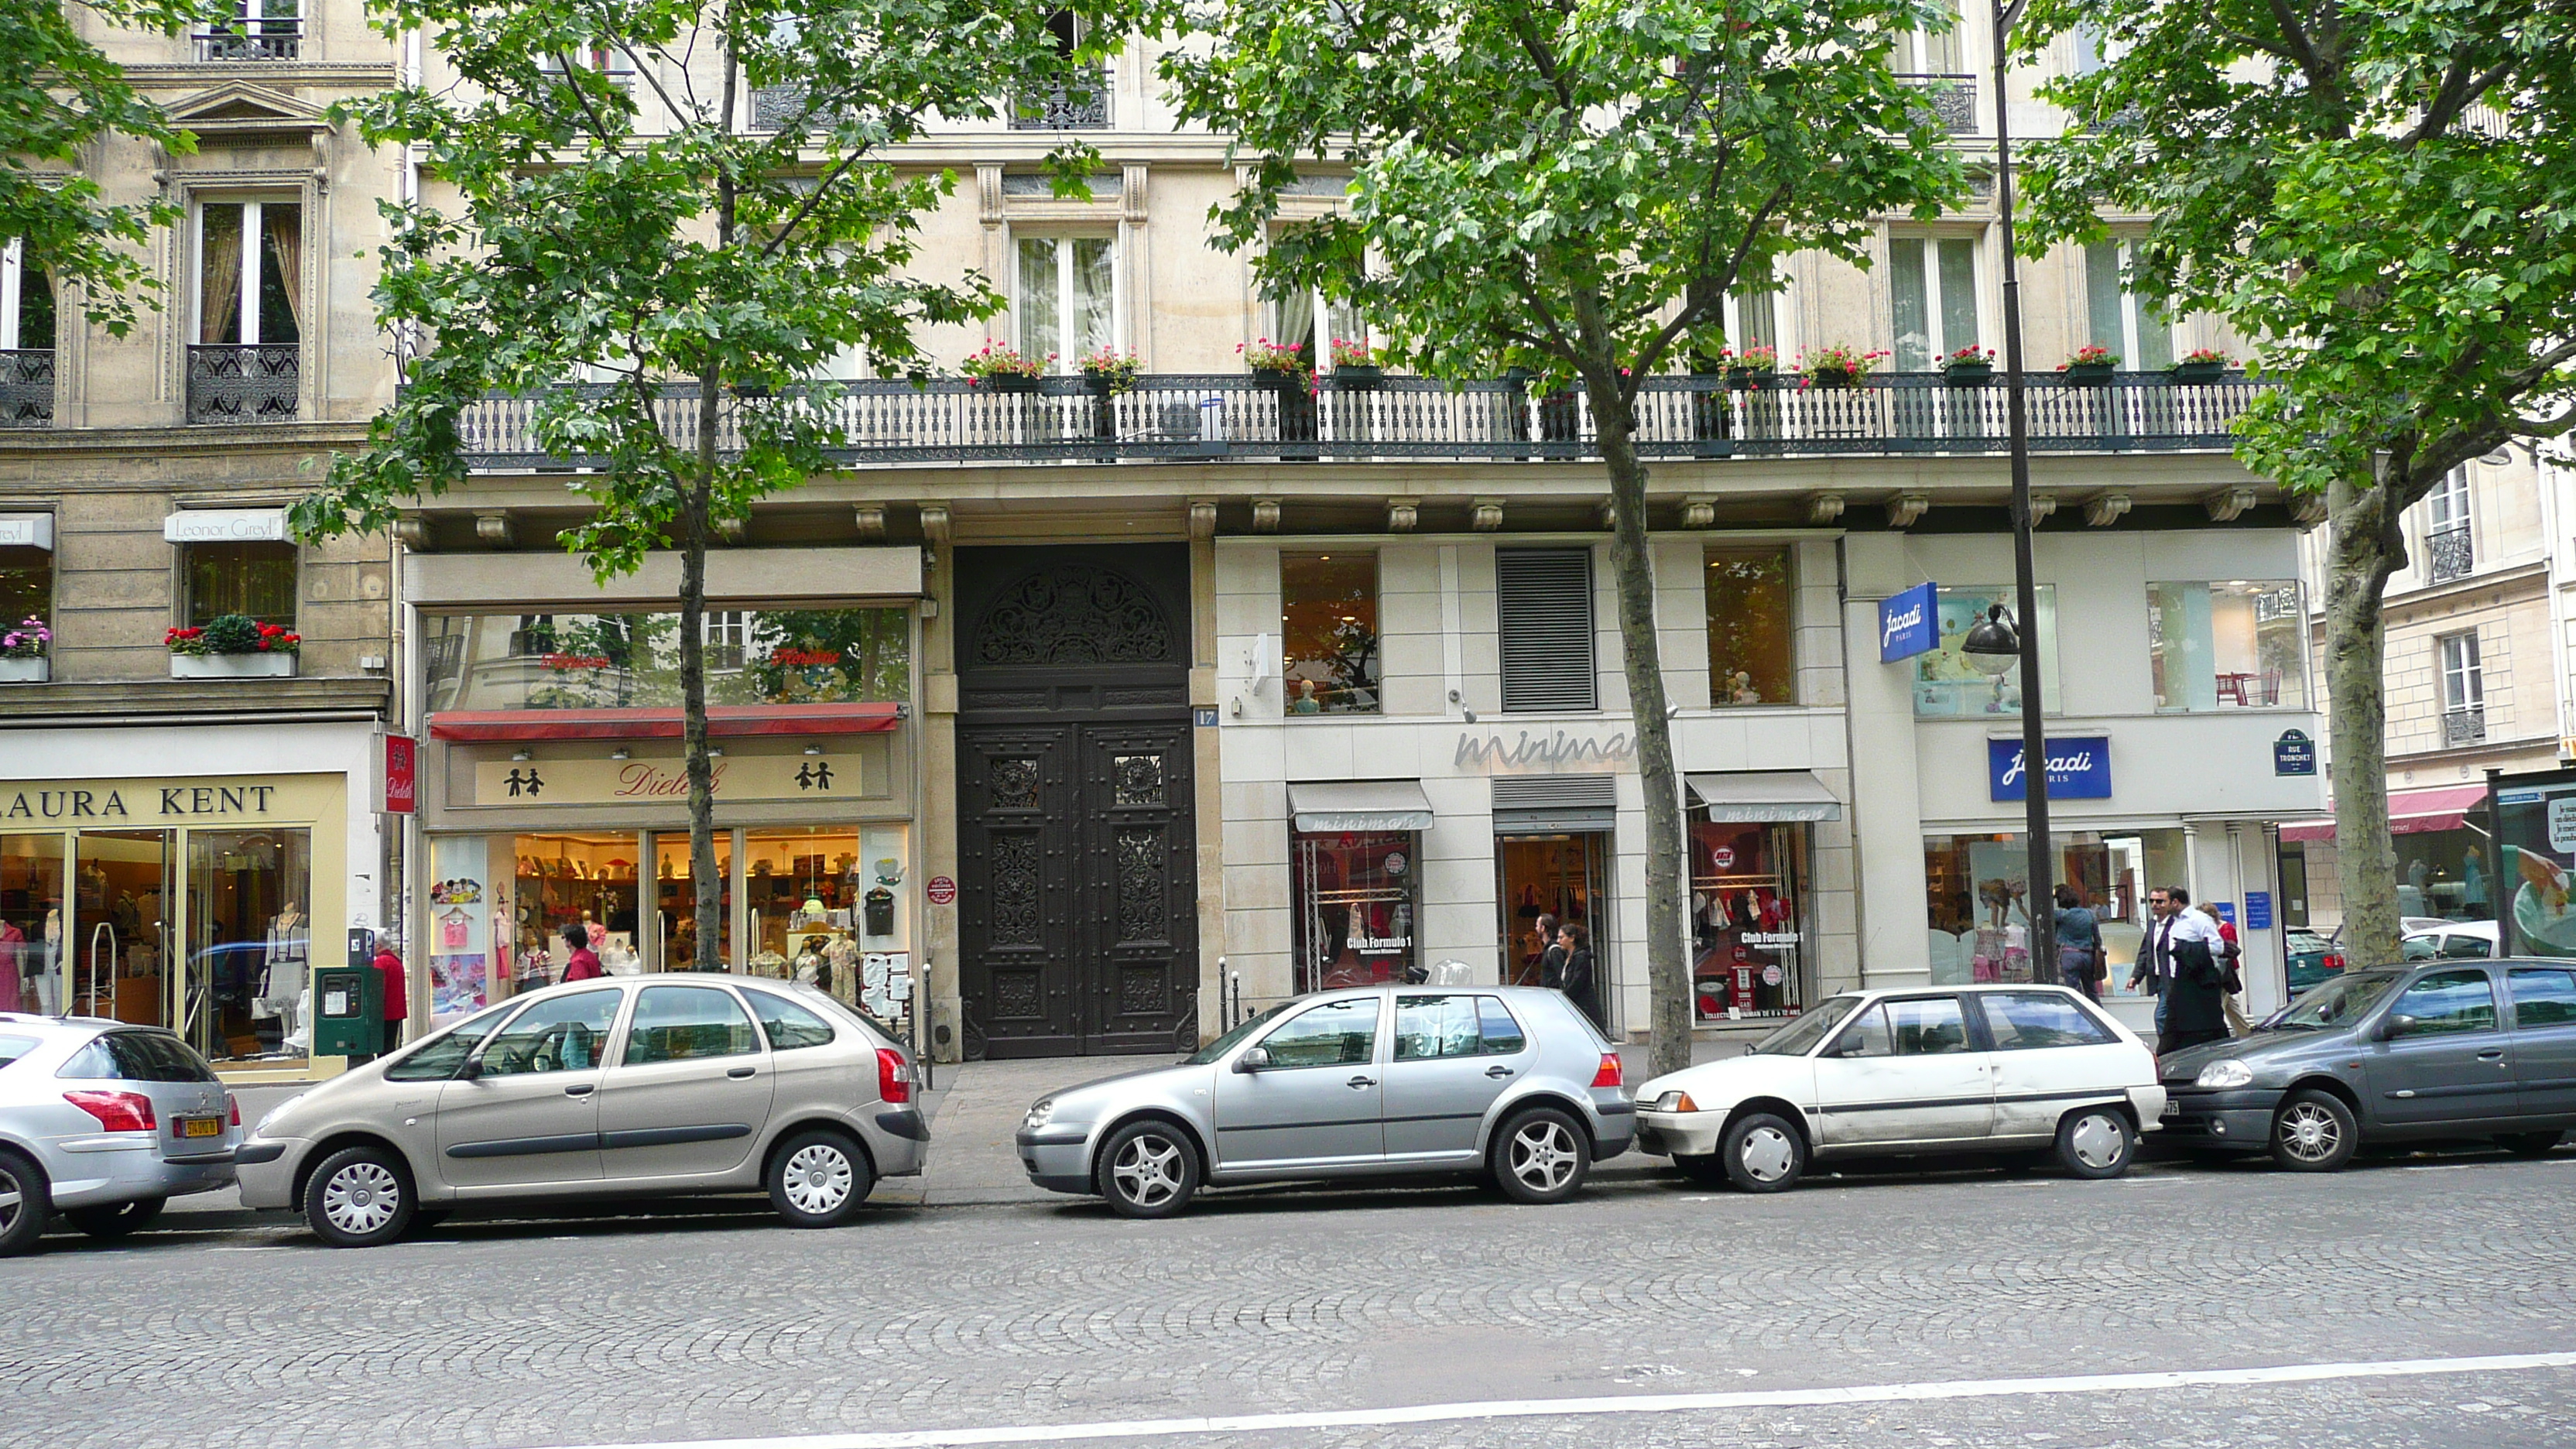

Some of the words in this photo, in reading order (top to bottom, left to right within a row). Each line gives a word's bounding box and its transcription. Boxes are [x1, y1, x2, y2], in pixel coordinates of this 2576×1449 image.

[175, 519, 225, 537] Leonor
[231, 517, 273, 539] Greyl
[1884, 603, 1921, 648] jacadi
[1896, 630, 1912, 642] PARIS
[1200, 711, 1214, 724] 17
[2280, 754, 2311, 762] TRONCHET
[2002, 748, 2092, 786] jadi
[614, 763, 728, 796] Dieleh
[0, 790, 128, 817] AURA
[159, 786, 274, 814] KENT
[1725, 807, 1826, 821] miniman
[1314, 815, 1416, 830] miniman
[1347, 937, 1368, 949] Club
[1369, 936, 1406, 948] Formule
[1406, 936, 1412, 947] 1
[1742, 932, 1762, 944] Club
[1762, 931, 1798, 943] Formule
[1799, 931, 1804, 942] 1
[2168, 1101, 2178, 1115] 75
